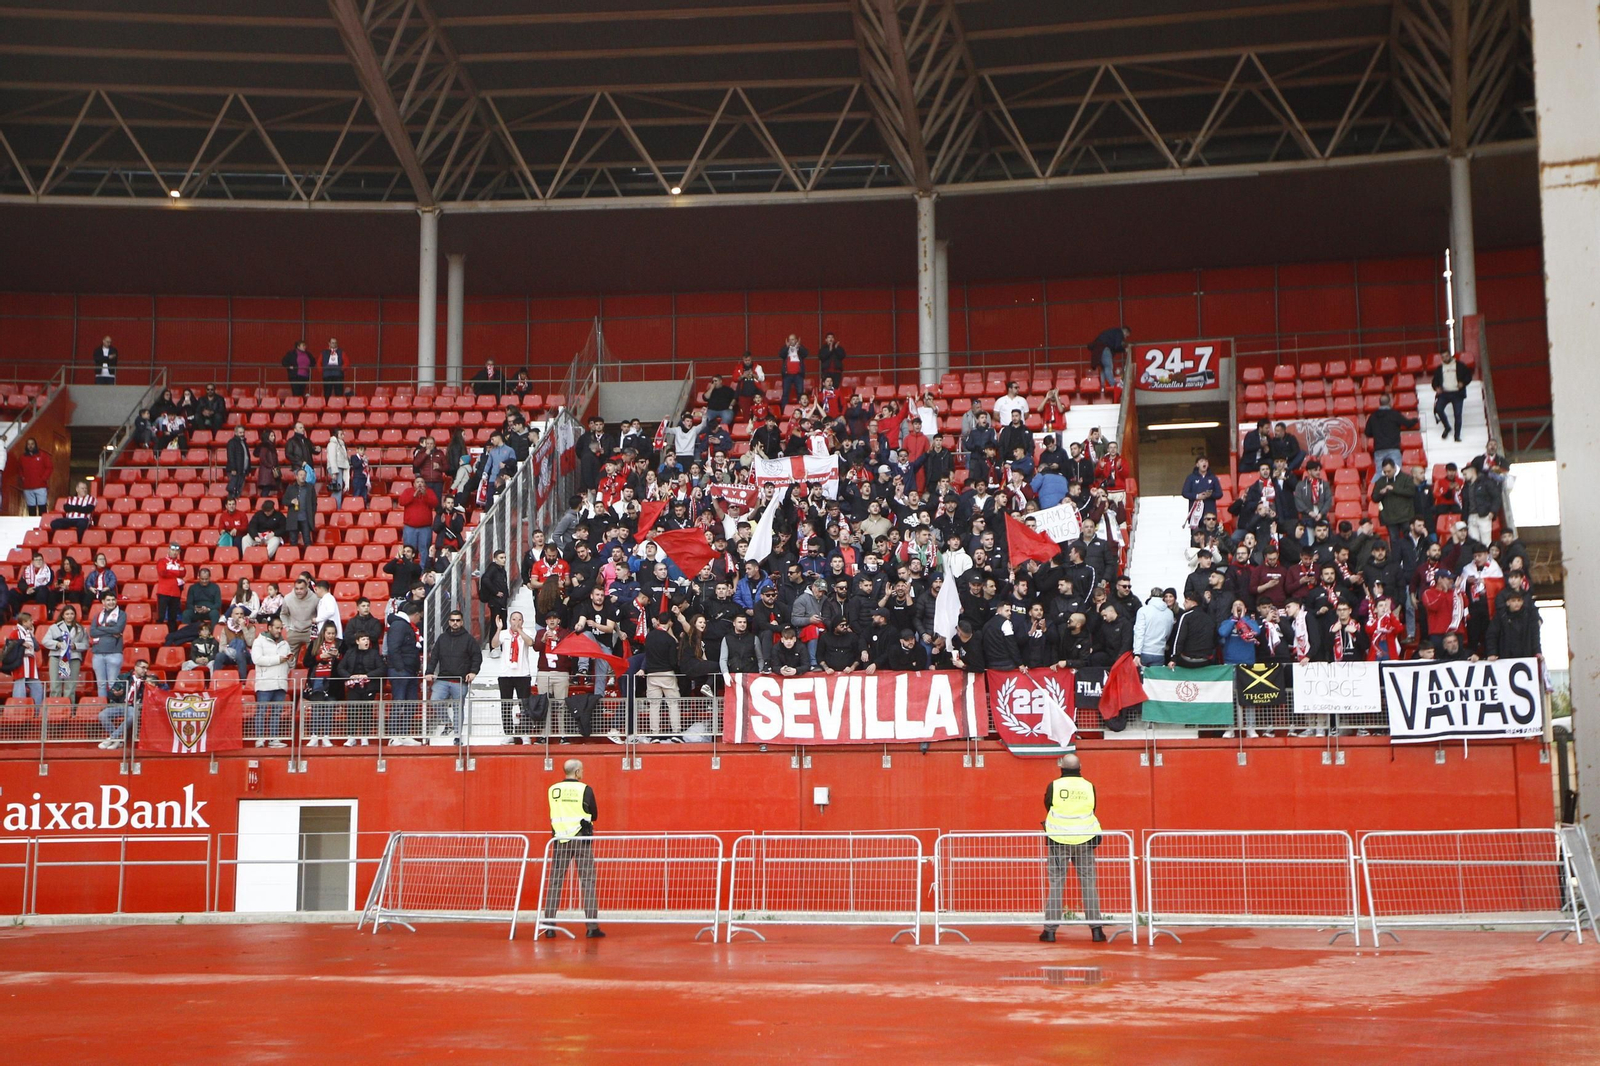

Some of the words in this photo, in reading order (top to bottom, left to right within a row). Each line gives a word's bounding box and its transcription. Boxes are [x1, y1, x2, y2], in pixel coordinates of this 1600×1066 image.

[1145, 346, 1213, 376] 24-7
[1036, 506, 1072, 527] STAMOS
[1304, 680, 1363, 697] JORGE
[1428, 688, 1499, 705] DONDE
[750, 673, 959, 740] SEVILLA
[1012, 689, 1049, 714] 22
[0, 784, 210, 831] aixaBank
